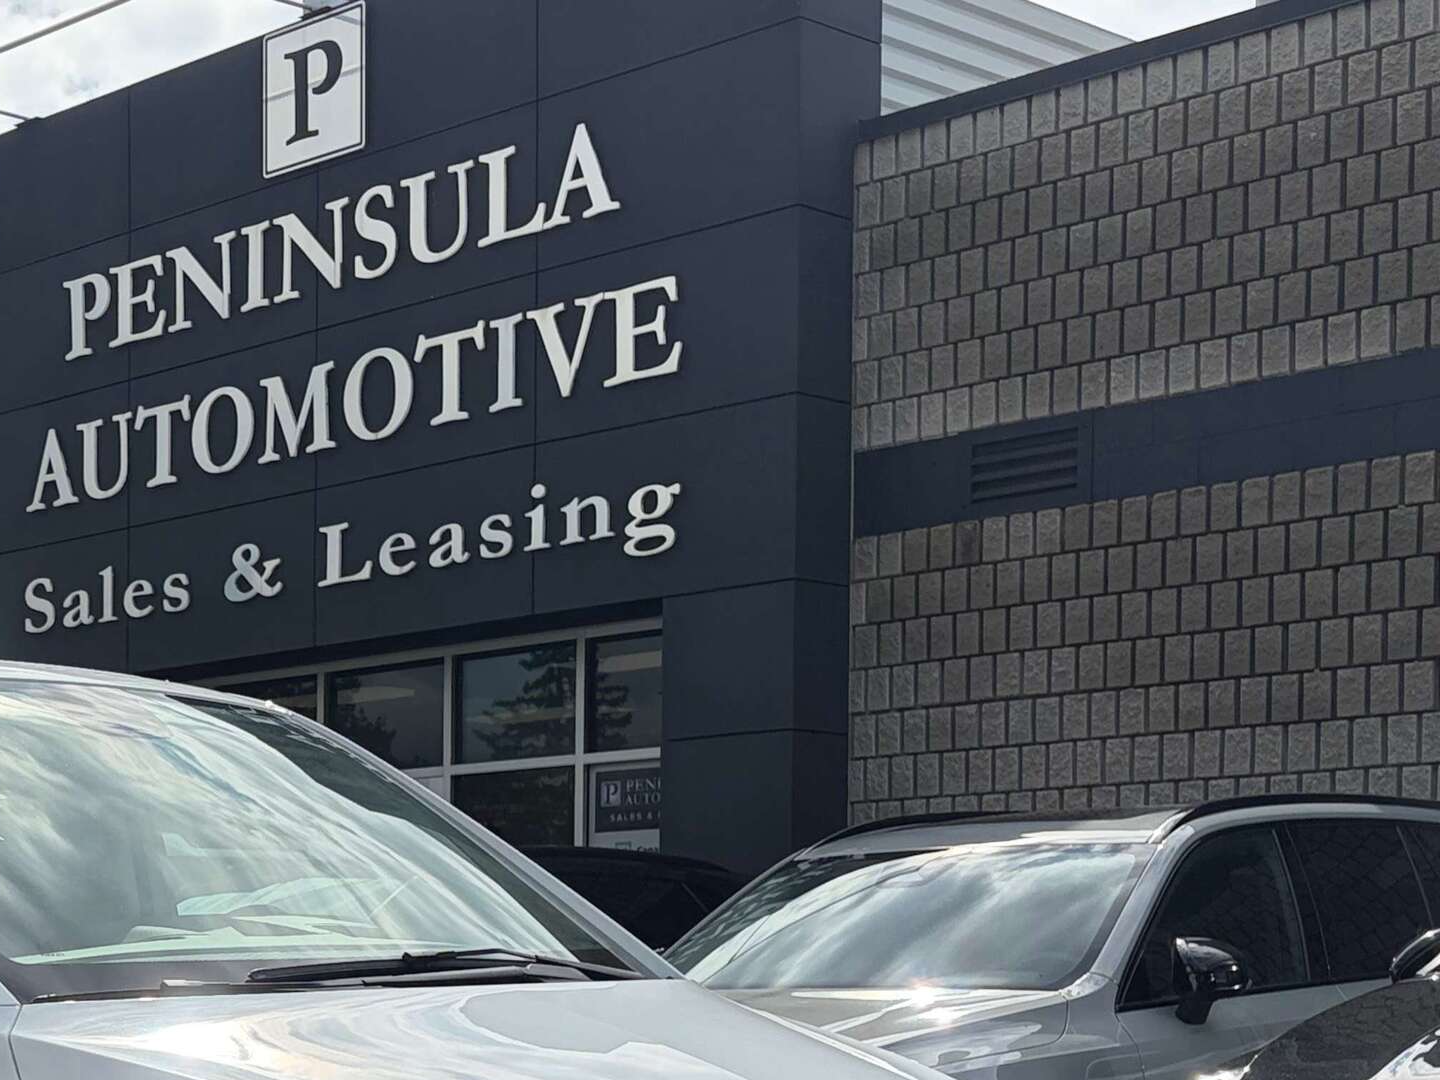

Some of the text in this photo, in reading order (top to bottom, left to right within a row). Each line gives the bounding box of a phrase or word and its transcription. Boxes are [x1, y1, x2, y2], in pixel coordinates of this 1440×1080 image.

[283, 40, 343, 146] P
[63, 122, 620, 361] PENINSULA
[26, 275, 683, 512] AUTOMOTIVE
[24, 481, 681, 634] Sales & Leasing
[604, 783, 618, 804] P
